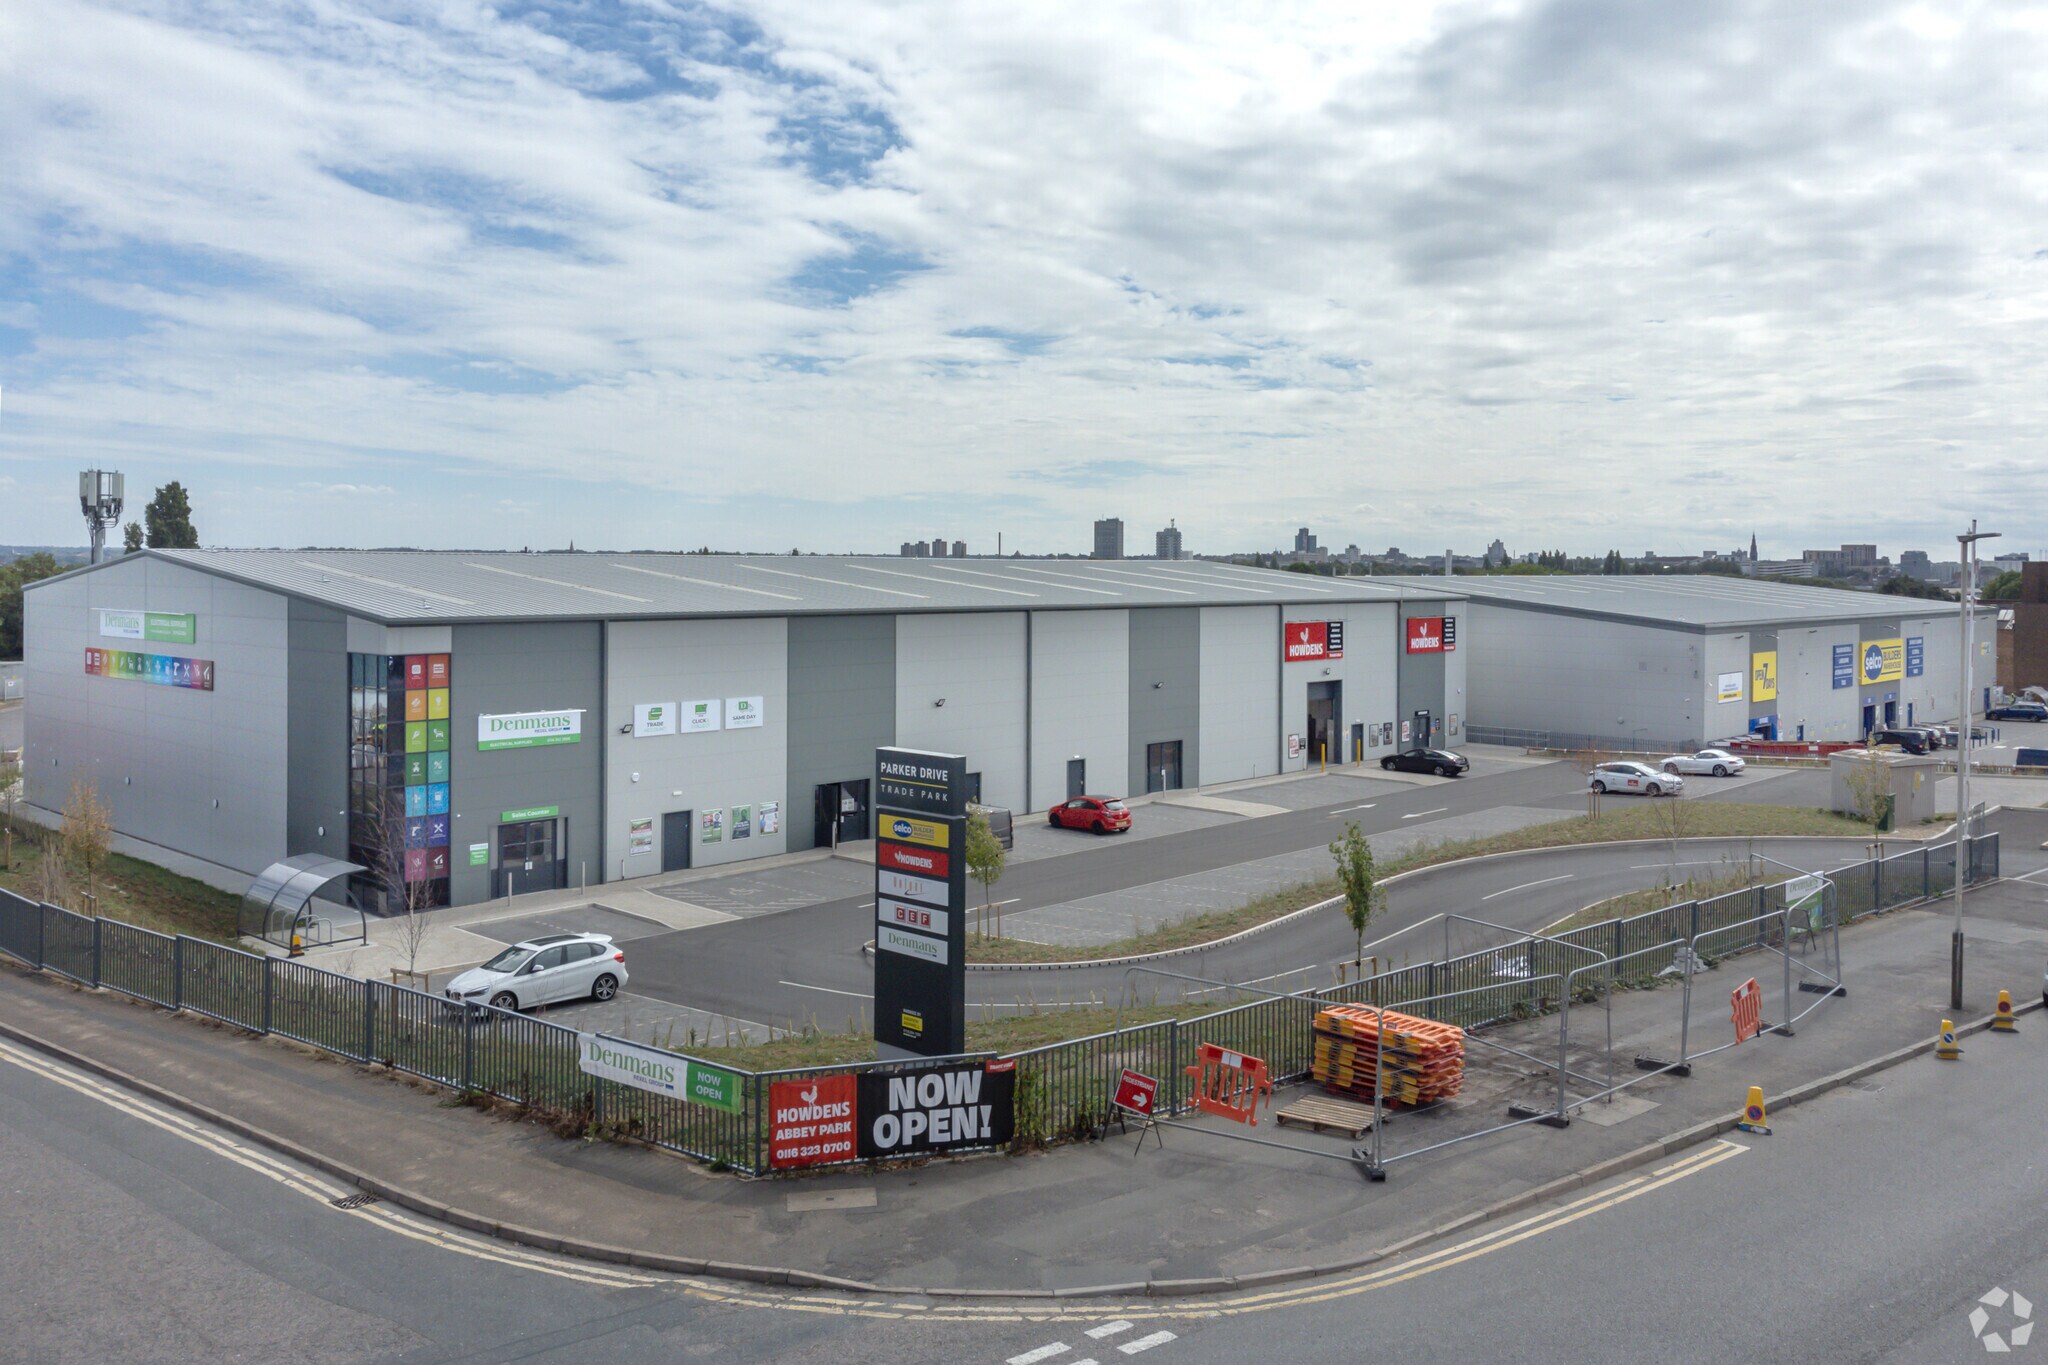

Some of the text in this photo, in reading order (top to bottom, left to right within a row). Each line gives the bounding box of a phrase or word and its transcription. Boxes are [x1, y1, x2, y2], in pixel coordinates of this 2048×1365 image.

[1290, 643, 1324, 657] HOWDENS
[1411, 637, 1439, 649] HOWDENS
[1865, 652, 1882, 671] selco
[1763, 663, 1769, 690] 7
[490, 715, 571, 732] Denmans
[880, 762, 948, 781] PARKER DRIVE
[880, 784, 948, 802] TRADE PARK
[527, 809, 550, 817] Counter
[894, 823, 912, 834] selco
[900, 854, 933, 869] HOWDENS
[888, 932, 938, 954] Denmans
[589, 1042, 675, 1083] Denmans
[633, 1074, 665, 1088] REXEL GROUP
[697, 1071, 722, 1087] NOW
[1123, 1075, 1154, 1091] PEDESTRIANS
[695, 1085, 722, 1101] OPEN
[889, 1070, 983, 1112] NOW
[777, 1101, 850, 1124] HOWDENS
[776, 1120, 851, 1141] ABBEY PARK
[873, 1105, 993, 1149] OPEN!
[776, 1141, 851, 1160] 0116 323 0700
